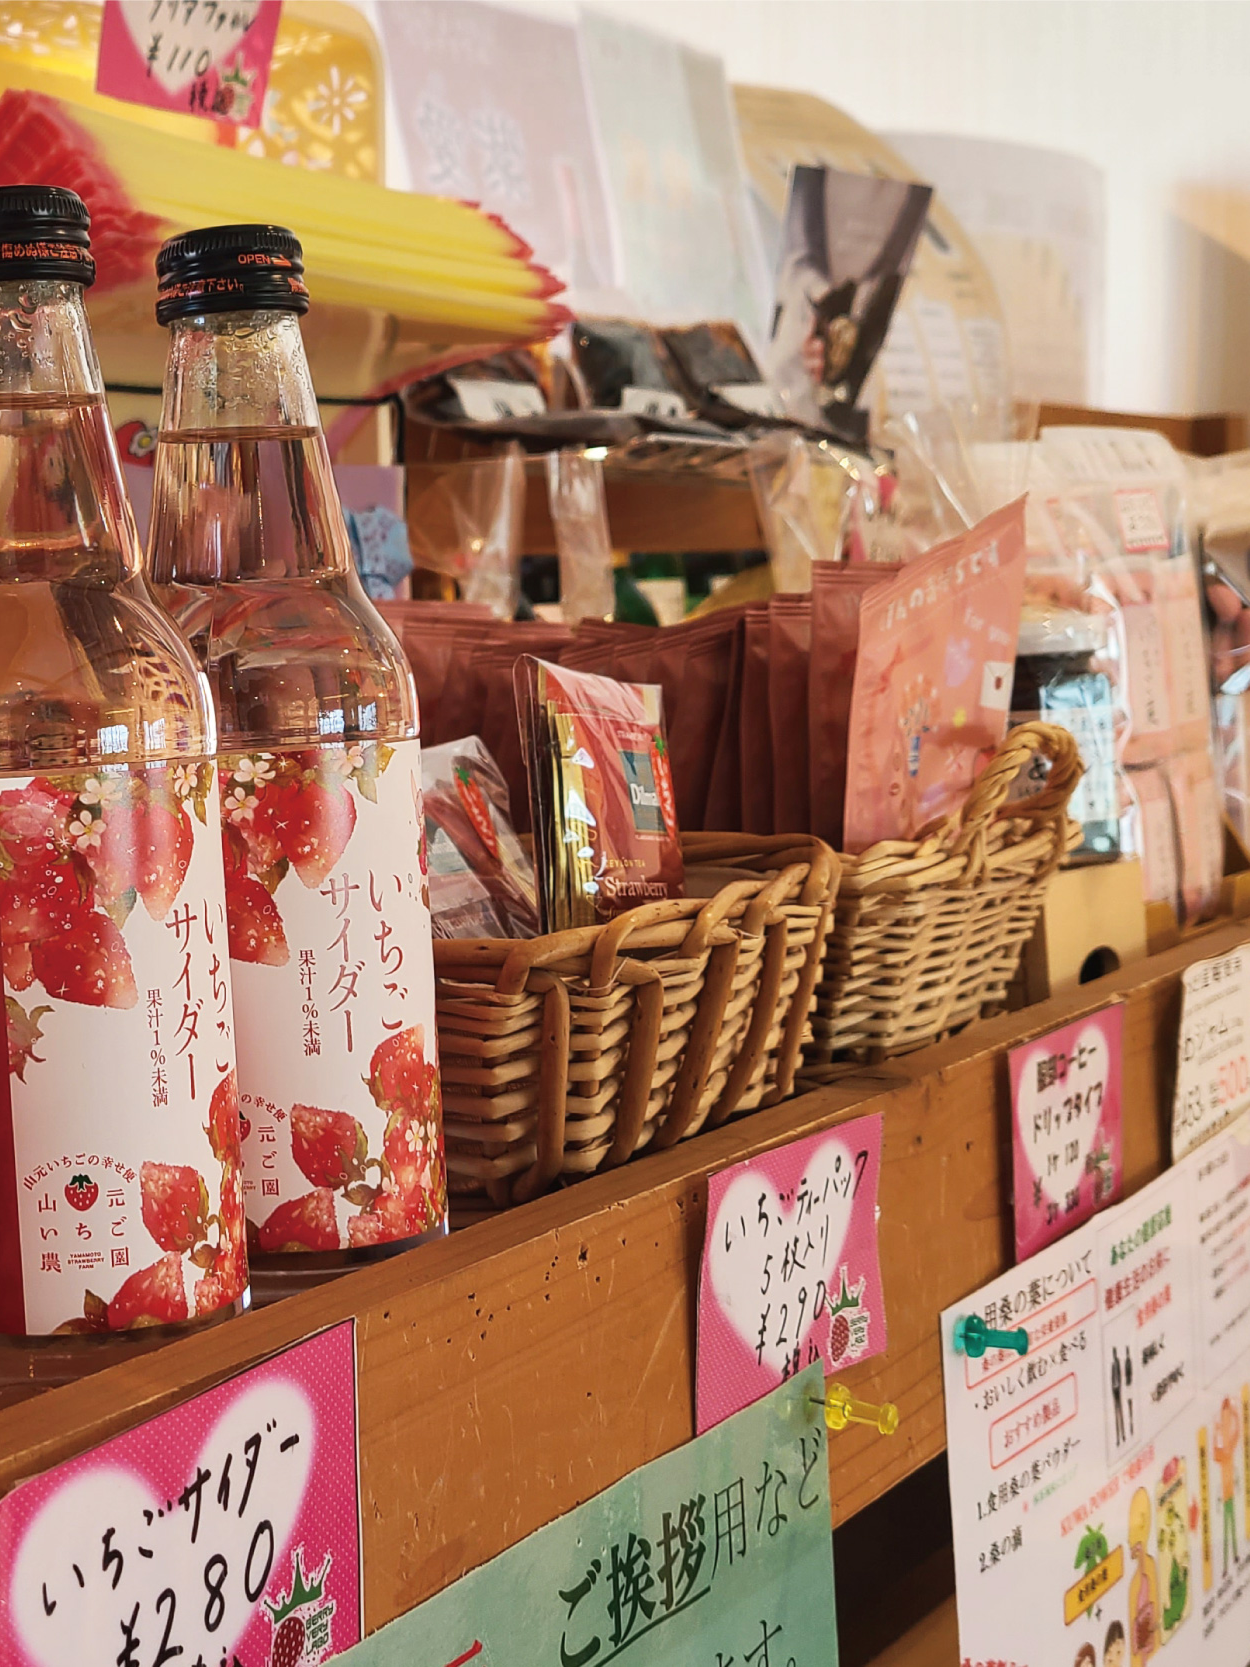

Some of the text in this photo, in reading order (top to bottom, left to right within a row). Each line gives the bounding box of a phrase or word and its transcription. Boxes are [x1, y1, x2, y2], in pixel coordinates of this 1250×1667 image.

[238, 254, 271, 265] OPEN
[604, 875, 668, 898] Strawberry
[606, 858, 646, 868] CEYLON TEA
[203, 897, 232, 1074] いちご
[320, 871, 366, 1054] サイダー
[367, 869, 408, 1029] いちご
[164, 903, 205, 1100] サイダー
[298, 949, 322, 1057] 果汁1%未満
[145, 987, 169, 1108] 果汁1%未満
[23, 1153, 137, 1191] 山元いちごの幸せ便
[257, 1126, 276, 1143] 元
[262, 1151, 278, 1169] ご
[261, 1178, 279, 1196] 園
[67, 1257, 105, 1265] STRAWBERRY
[761, 1214, 830, 1295] 5枚入り
[973, 1250, 1093, 1329] 用桑の葉について
[755, 1280, 826, 1366] ¥290
[42, 1419, 299, 1616] いちごサイダー
[558, 1428, 822, 1667] ご挨拶用など
[116, 1519, 275, 1667] ¥280
[306, 1603, 334, 1630] BERRY
[306, 1620, 328, 1641] VERY
